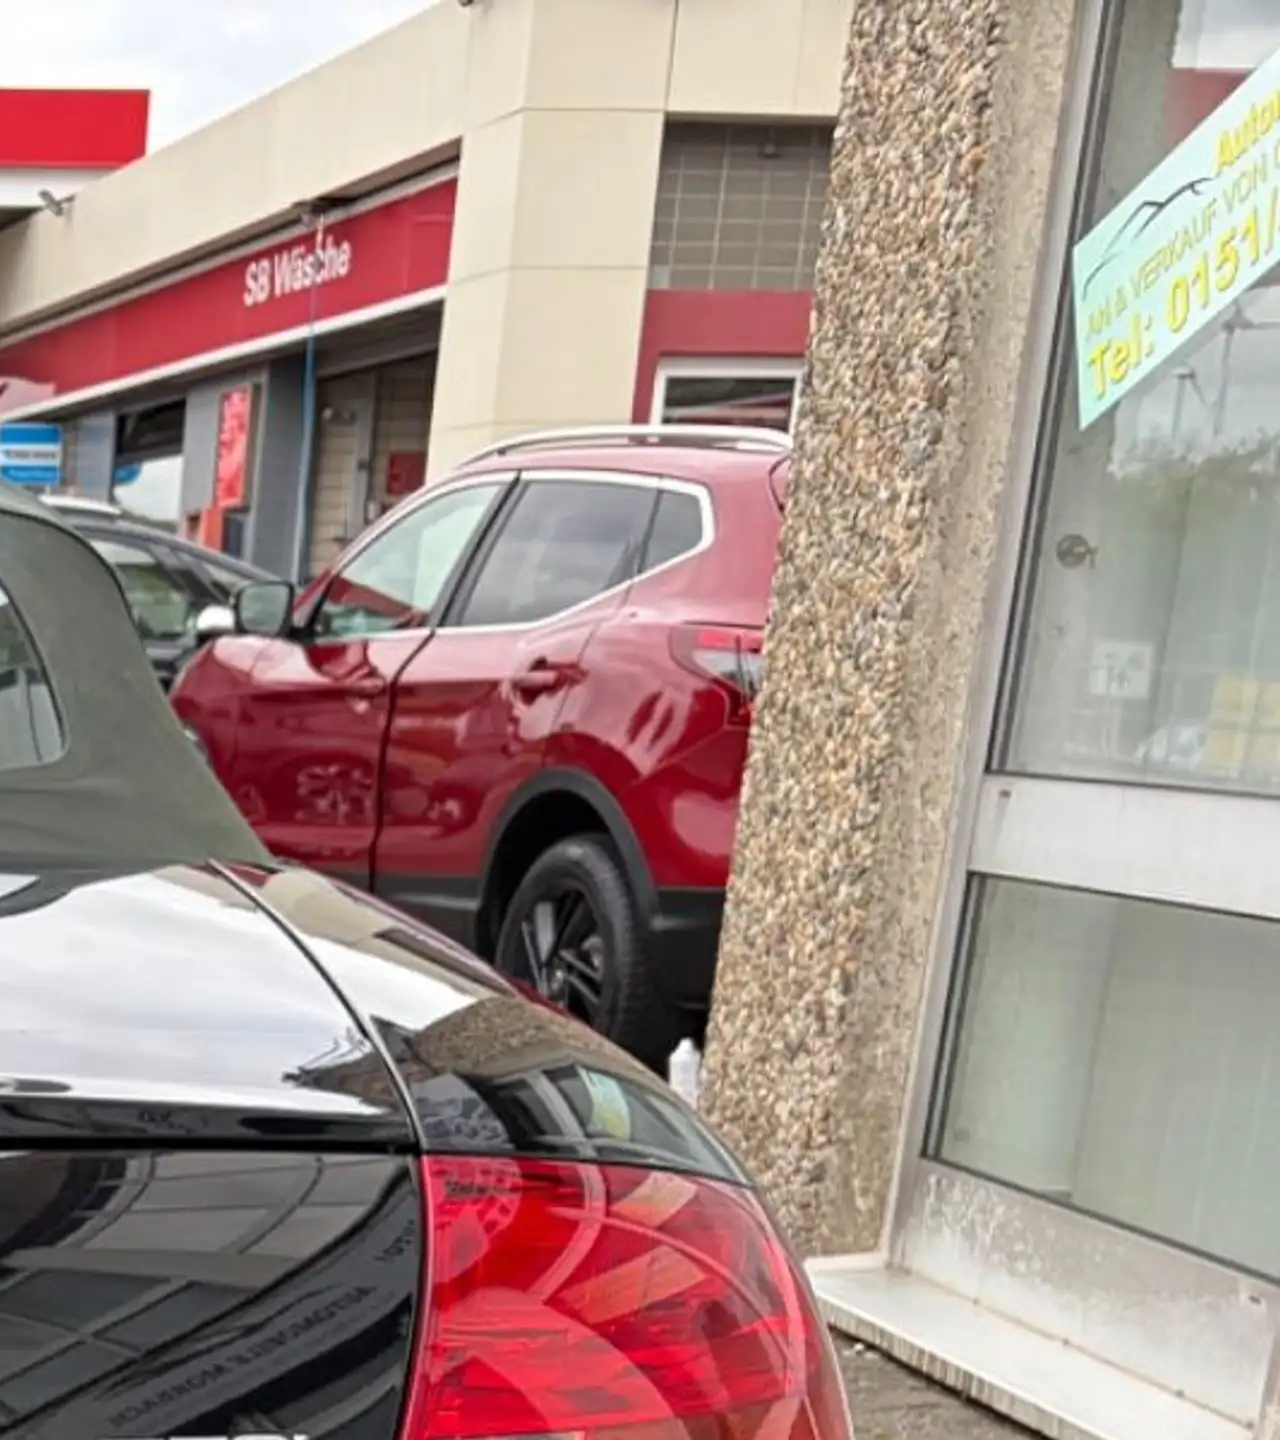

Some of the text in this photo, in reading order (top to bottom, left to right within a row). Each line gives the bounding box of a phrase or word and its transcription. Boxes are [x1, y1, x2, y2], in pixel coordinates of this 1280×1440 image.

[1129, 198, 1217, 298] VERKAUF
[1223, 152, 1268, 213] VON
[243, 258, 271, 307] SB
